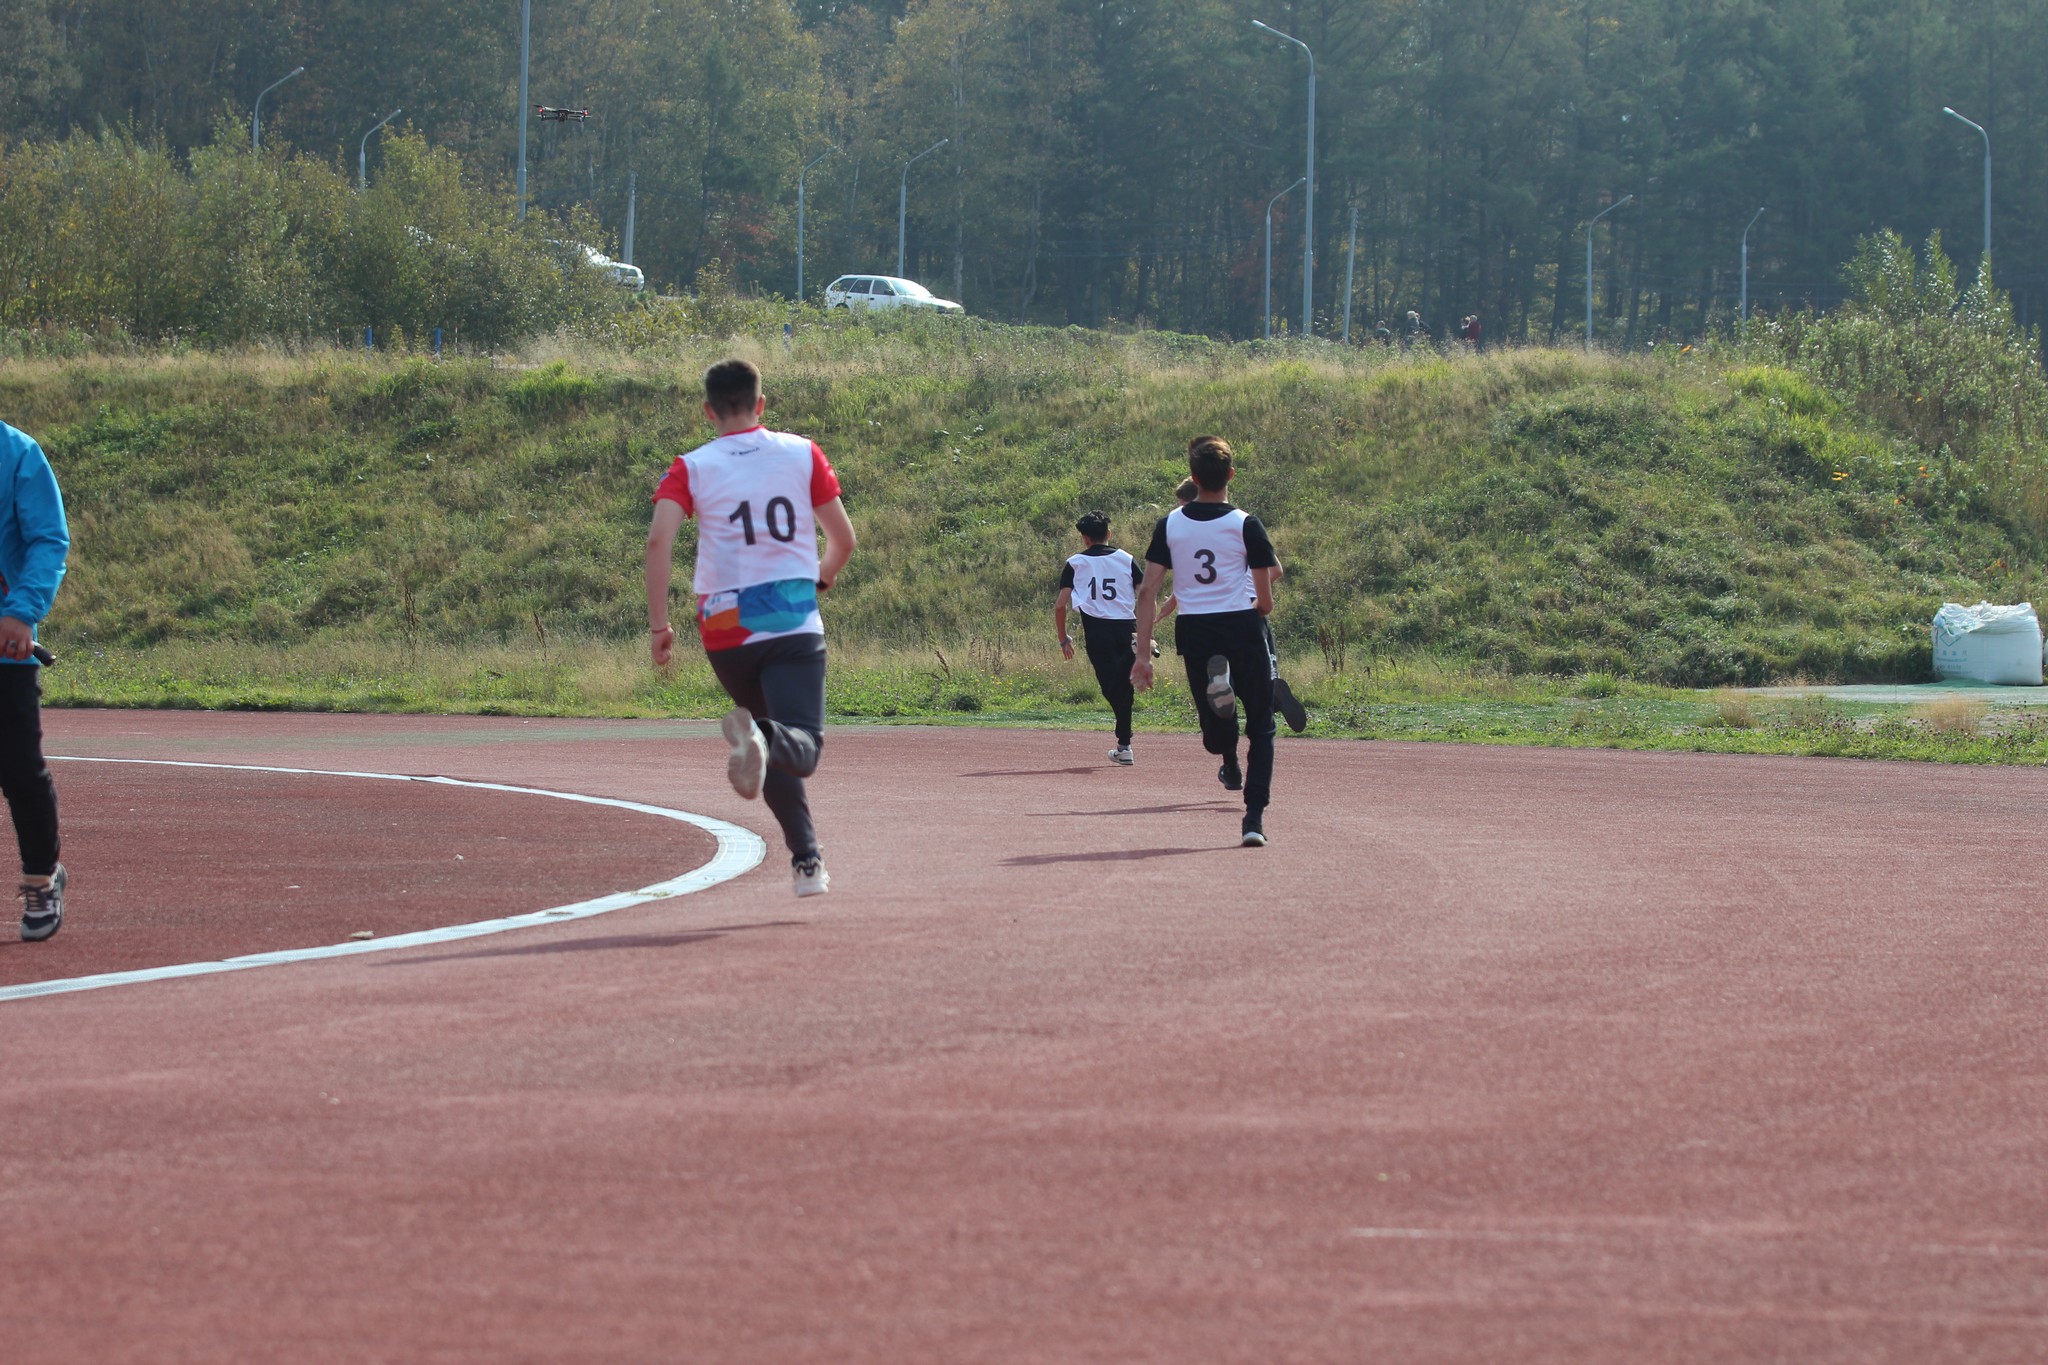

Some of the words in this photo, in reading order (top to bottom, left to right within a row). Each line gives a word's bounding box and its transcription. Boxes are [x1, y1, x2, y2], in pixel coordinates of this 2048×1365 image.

[729, 496, 797, 546] 10
[1193, 548, 1218, 585] 3
[1087, 576, 1118, 601] 15
